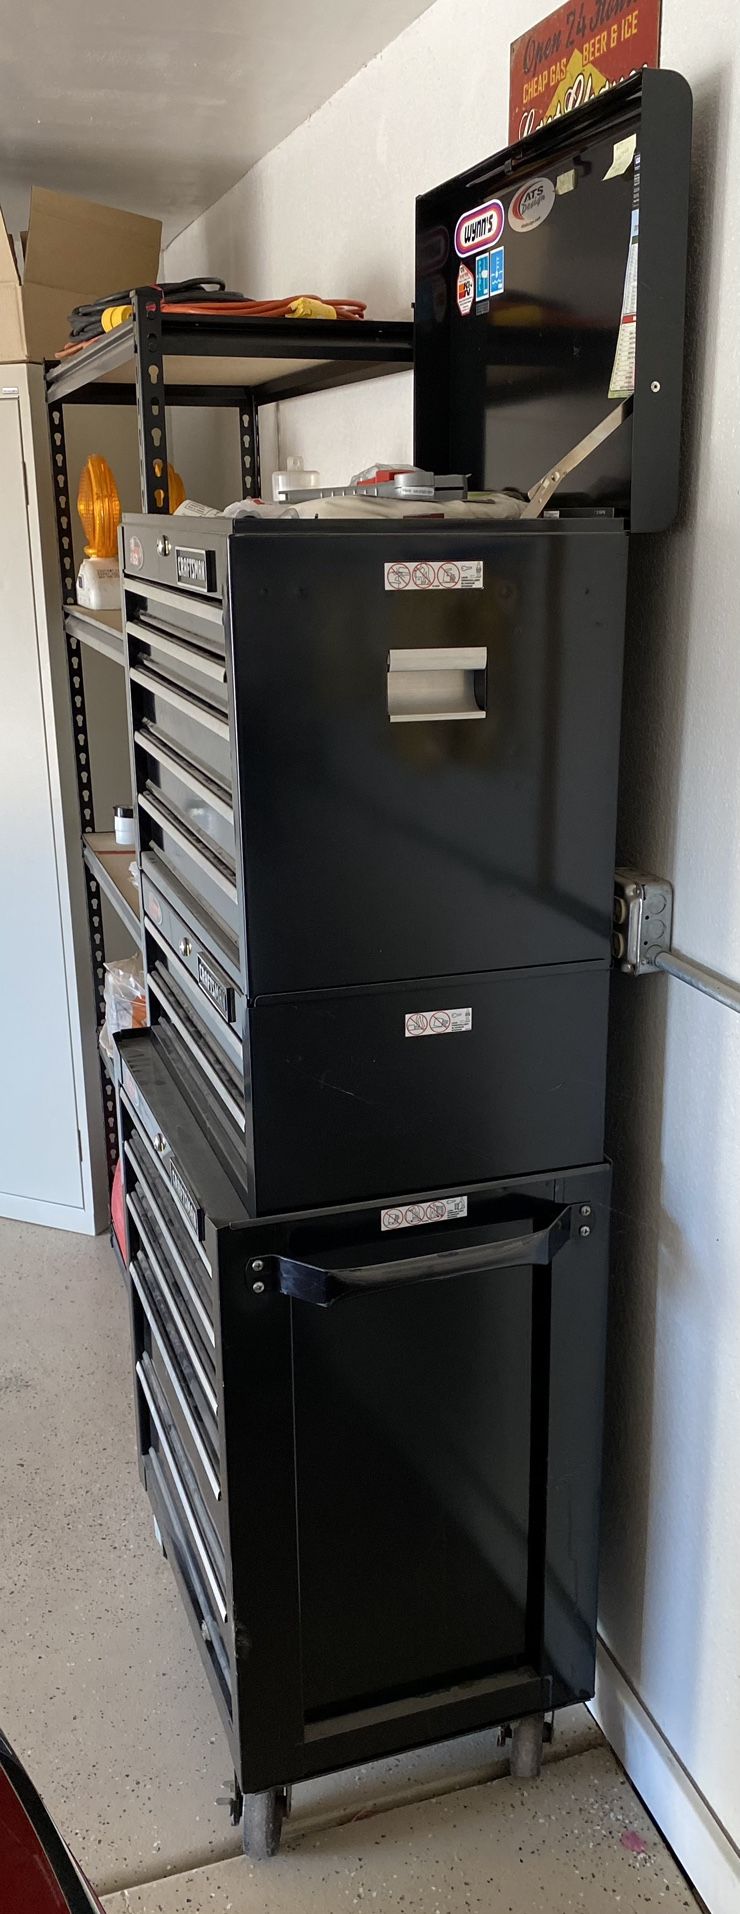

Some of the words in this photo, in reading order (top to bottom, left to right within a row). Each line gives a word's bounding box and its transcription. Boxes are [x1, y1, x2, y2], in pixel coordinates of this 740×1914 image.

[523, 30, 561, 76] Open
[566, 3, 586, 48] 24
[583, 30, 607, 64] BEER
[621, 10, 638, 42] ICE
[523, 73, 547, 104] CHEAP
[550, 58, 566, 87] GAS
[524, 186, 543, 203] ATS
[178, 556, 204, 580] CRAFTSMAN
